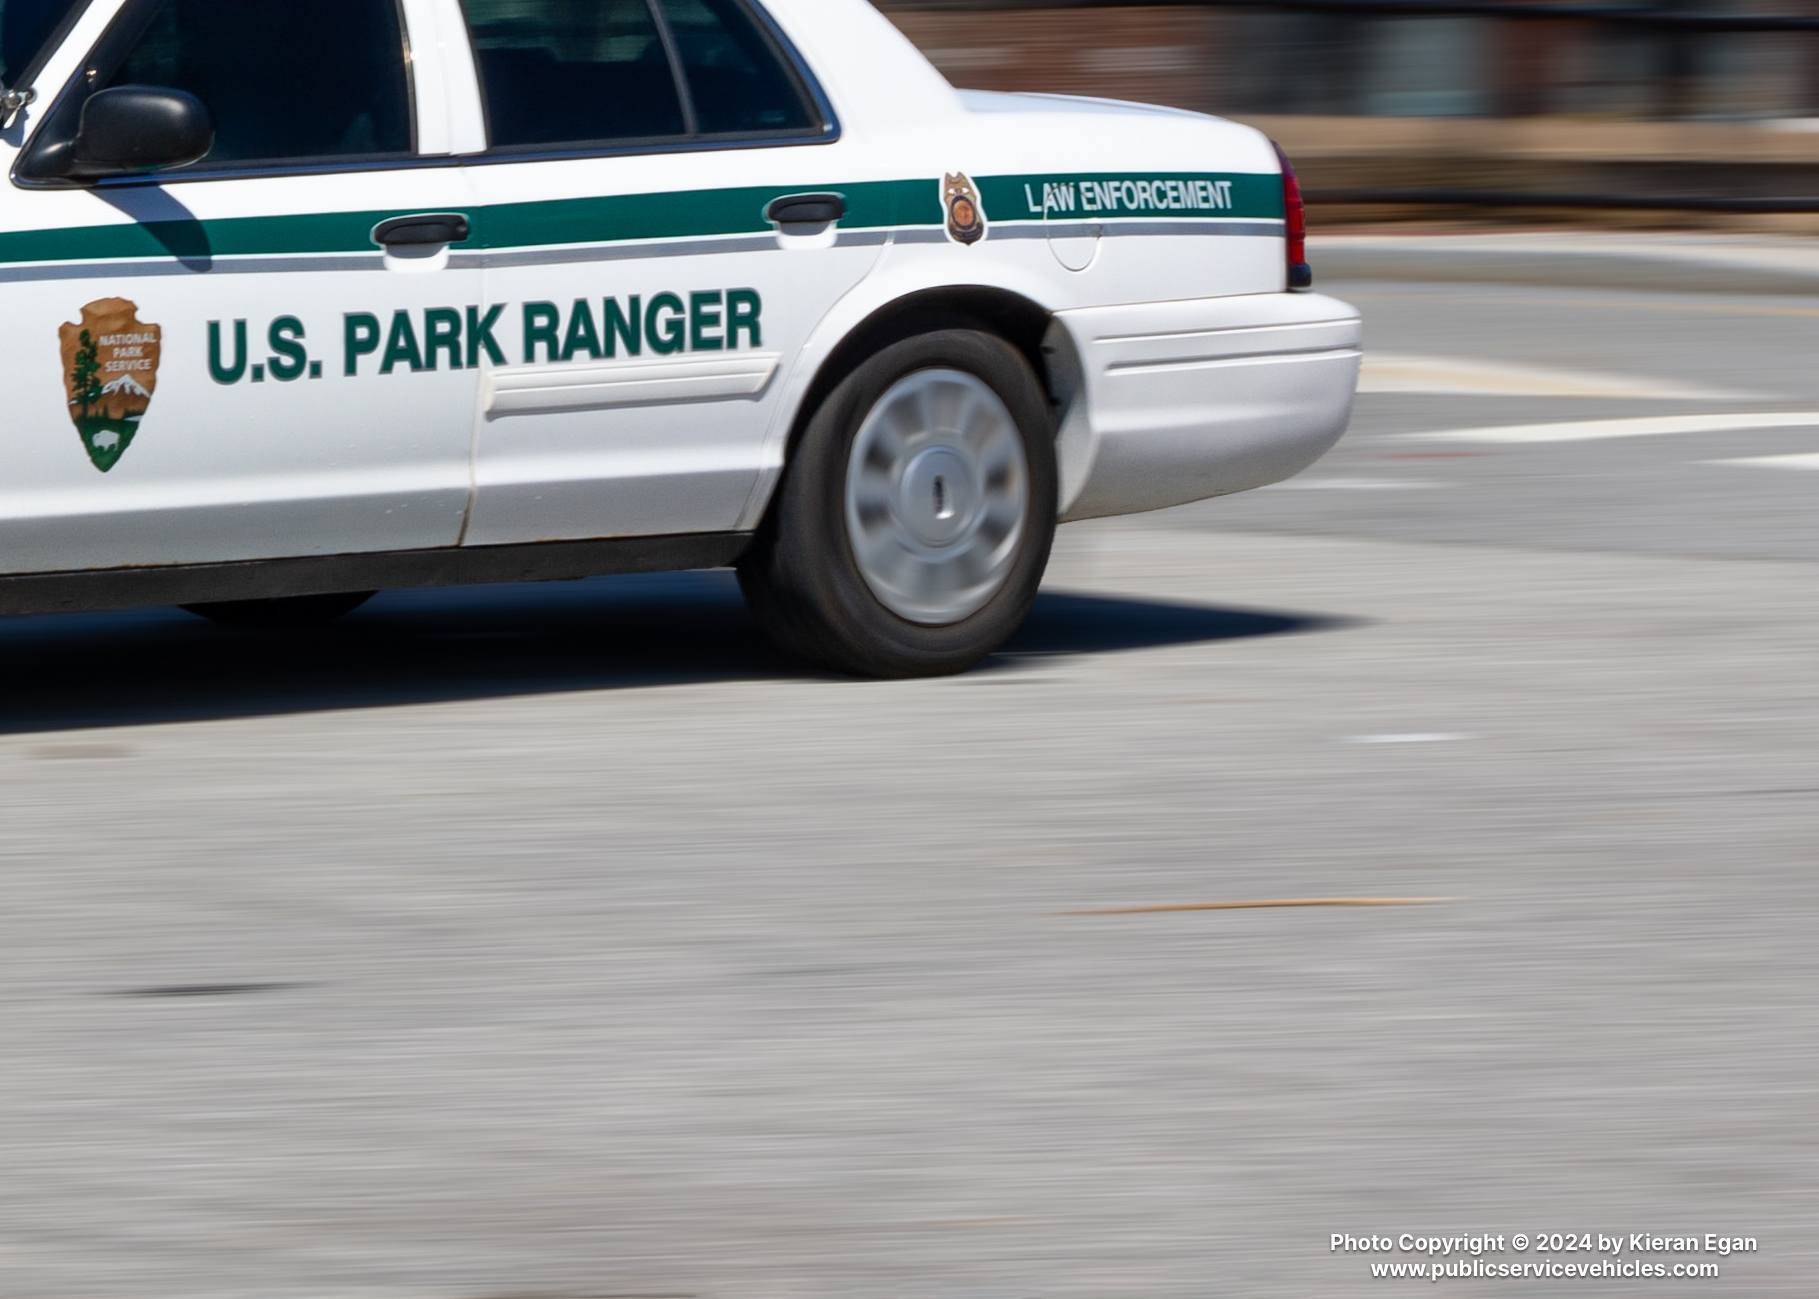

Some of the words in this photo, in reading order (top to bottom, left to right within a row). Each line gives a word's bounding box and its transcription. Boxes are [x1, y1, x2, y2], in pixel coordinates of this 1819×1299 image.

[1024, 181, 1075, 213] LAW
[1079, 180, 1232, 211] ENFORCEMENT
[99, 333, 156, 346] NATIONAL
[206, 314, 322, 385] U.S.
[342, 302, 508, 377] PARK
[522, 287, 762, 363] RANGER
[113, 346, 143, 358] PARK
[105, 359, 152, 372] SERVICE
